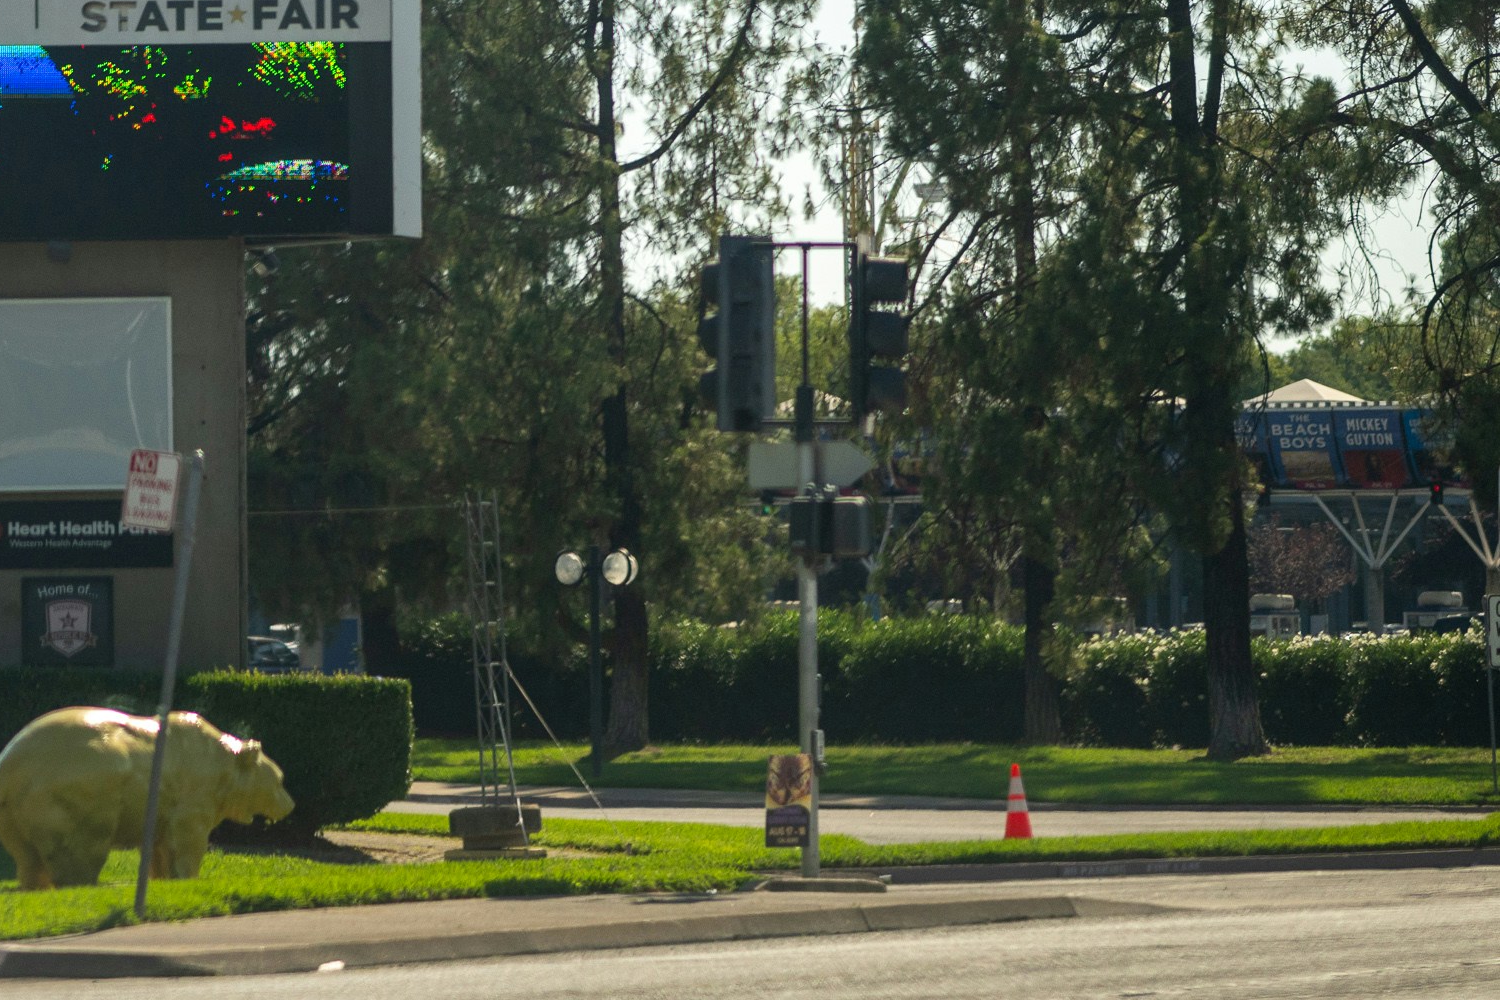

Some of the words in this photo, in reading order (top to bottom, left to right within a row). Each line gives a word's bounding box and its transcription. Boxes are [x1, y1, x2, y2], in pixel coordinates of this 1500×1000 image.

[80, 0, 224, 33] STATE
[1289, 413, 1312, 423] THE
[1345, 418, 1389, 431] MICKEY
[1271, 423, 1331, 436] BEACH
[1279, 437, 1327, 449] BOYS
[1345, 433, 1394, 446] GUYTON
[132, 453, 157, 474] NO
[7, 521, 56, 536] Heart
[59, 520, 115, 536] Health
[9, 538, 43, 548] Western
[45, 538, 71, 548] Health
[72, 538, 112, 549] Advantage
[37, 584, 74, 599] Home
